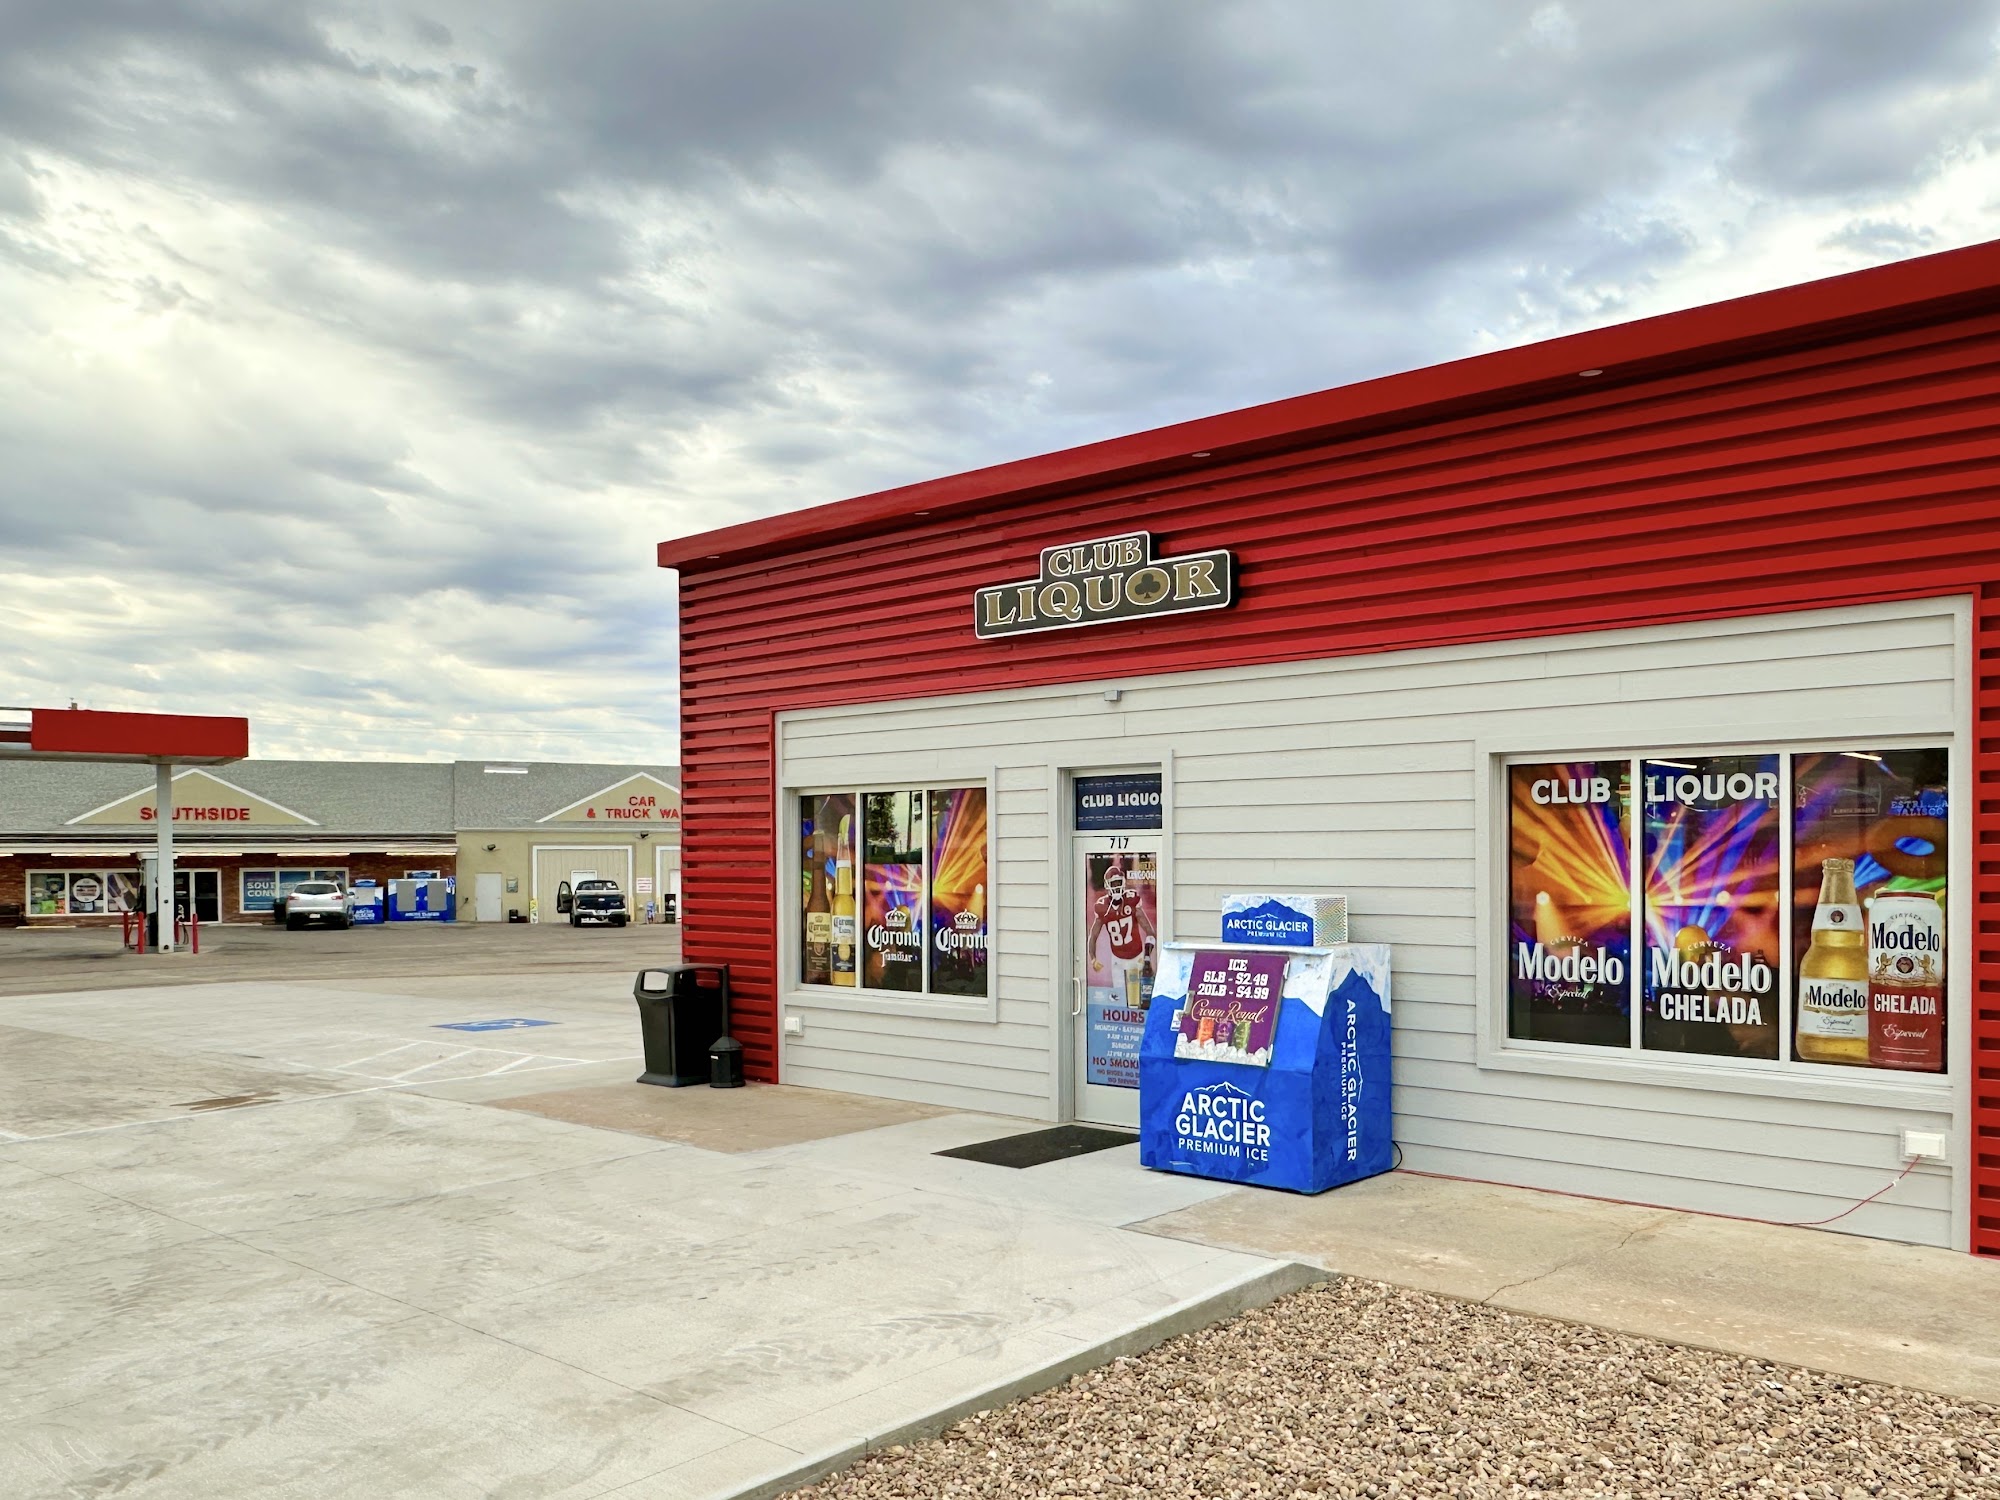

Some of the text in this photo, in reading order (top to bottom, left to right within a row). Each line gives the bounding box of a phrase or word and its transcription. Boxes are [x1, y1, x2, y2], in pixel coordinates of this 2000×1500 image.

[1048, 538, 1142, 577] CLUB
[984, 559, 1221, 627] LIQUOR
[1081, 792, 1162, 808] CLUB LIQUO
[1530, 772, 1778, 805] CLUB LIQUOR
[140, 807, 250, 820] SUTHSIDE
[586, 807, 596, 819] &
[605, 808, 651, 819] TRUCK
[629, 796, 656, 807] CAR
[1110, 837, 1129, 849] 717
[866, 924, 922, 951] Corona
[1107, 915, 1134, 947] 87
[1227, 919, 1308, 932] ARCTIC GLACIER
[1872, 922, 1940, 952] Modelo
[1550, 935, 1590, 947] CERVEZA
[1687, 940, 1731, 953] CERVEZA
[1228, 959, 1248, 971] ICE
[1518, 941, 1625, 985] Modelo
[1651, 946, 1772, 994] Modelo
[1203, 971, 1226, 983] 6LB
[1197, 983, 1227, 996] 20LB
[1809, 985, 1867, 1009] Modelo
[1102, 1008, 1145, 1024] HOURS
[1191, 999, 1269, 1026] Crown Royal
[1659, 993, 1763, 1026] CHELADA
[1874, 993, 1937, 1015] CHELADA
[1092, 1056, 1107, 1065] NO
[1346, 999, 1357, 1161] ARCTIC GLACIER
[1180, 1092, 1266, 1122] ARCTIC
[1175, 1113, 1271, 1147] GLACIER
[1178, 1137, 1269, 1162] PREMIUM ICE
